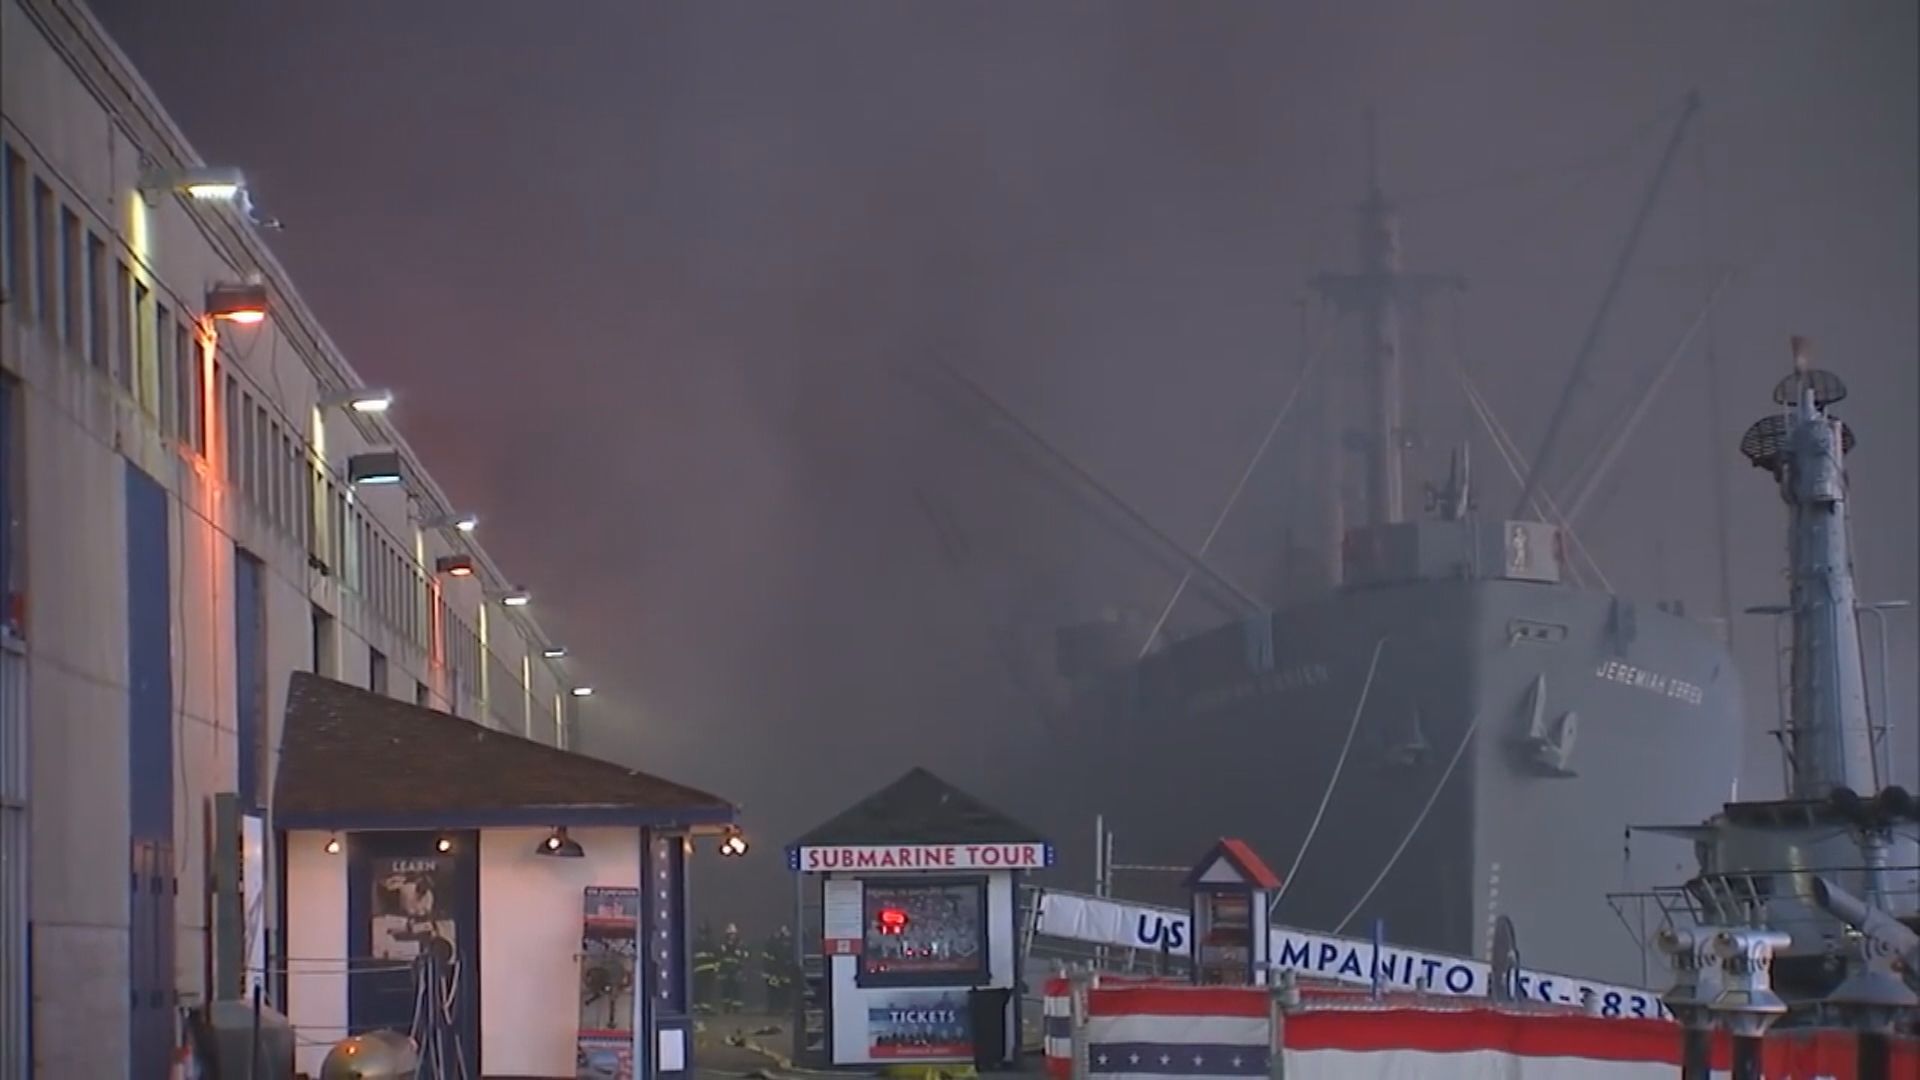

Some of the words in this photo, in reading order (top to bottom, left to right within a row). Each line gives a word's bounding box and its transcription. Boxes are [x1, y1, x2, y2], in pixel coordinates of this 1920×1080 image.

[392, 859, 436, 873] LEARN
[809, 848, 956, 868] SUBMARINE
[967, 846, 1038, 865] TOUR
[1136, 914, 1185, 949] US
[1280, 938, 1474, 994] MPANITO
[889, 1009, 955, 1024] TICKETS
